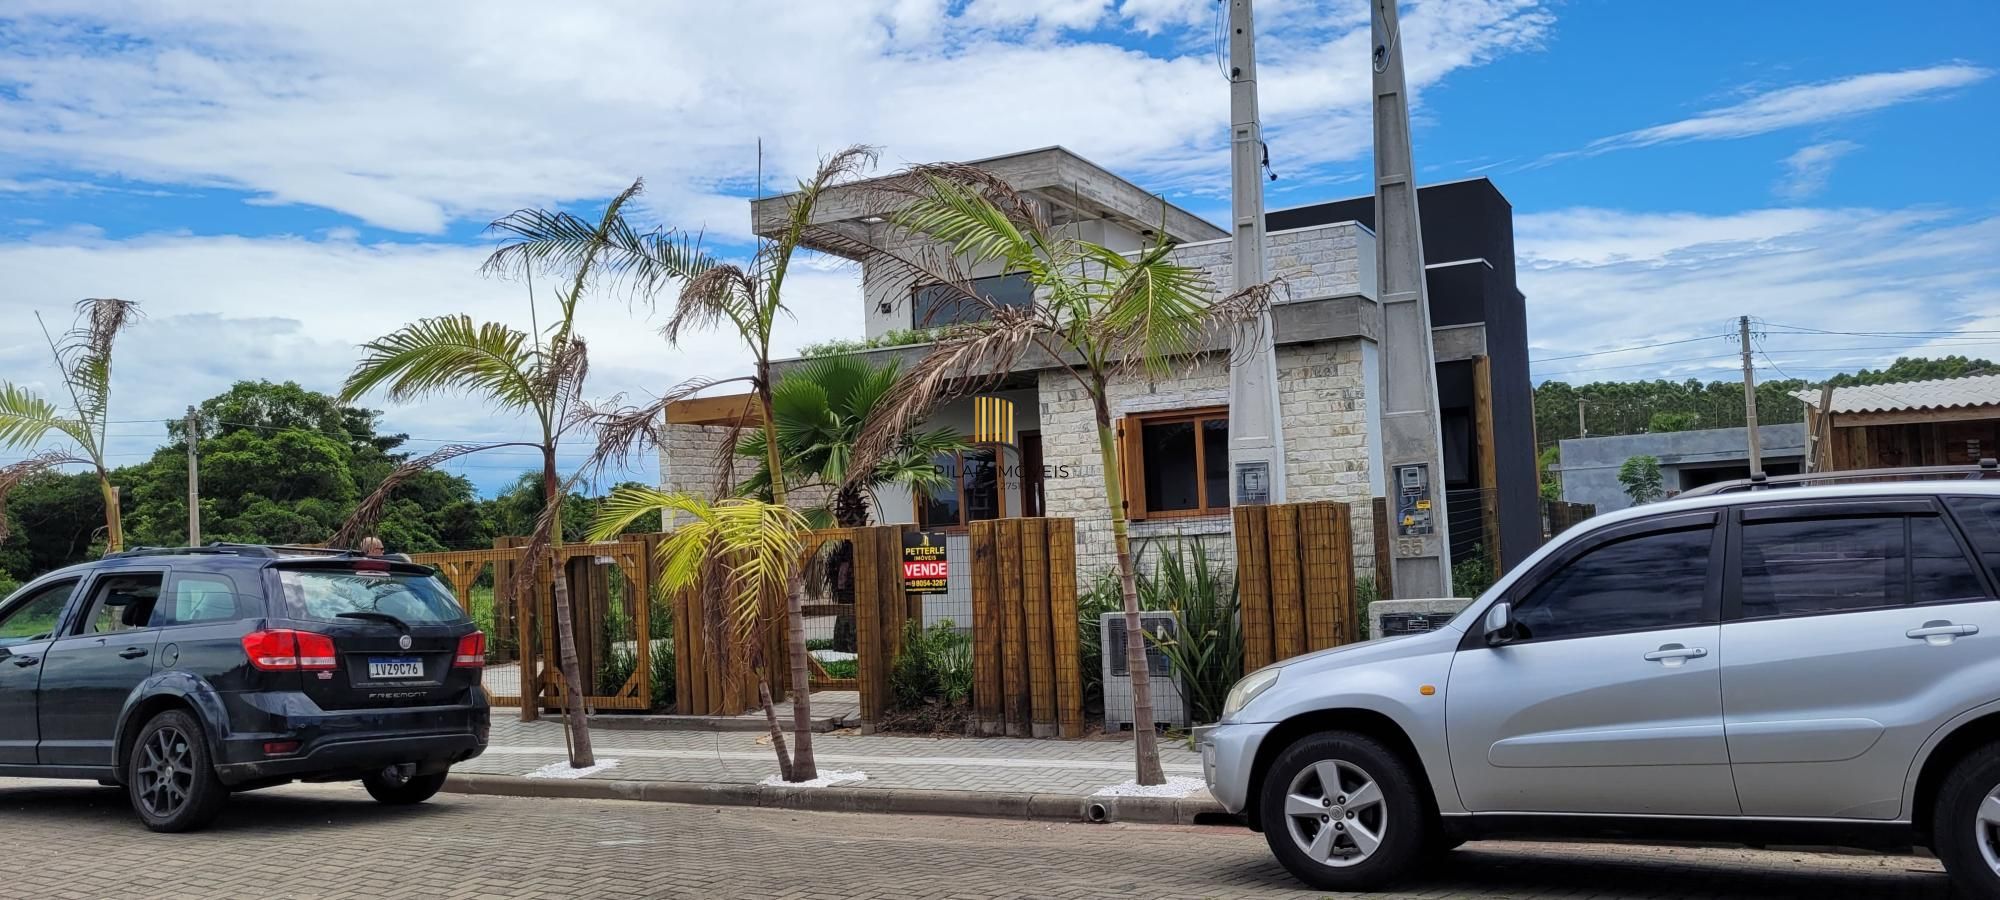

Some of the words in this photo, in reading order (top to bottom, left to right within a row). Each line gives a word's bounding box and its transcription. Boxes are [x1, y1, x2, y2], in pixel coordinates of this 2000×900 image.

[905, 546, 945, 556] PETTERLE
[1398, 537, 1424, 554] 55
[904, 562, 947, 577] VENDE
[374, 663, 418, 676] IVZ9C76
[368, 691, 428, 699] FREEMONT
